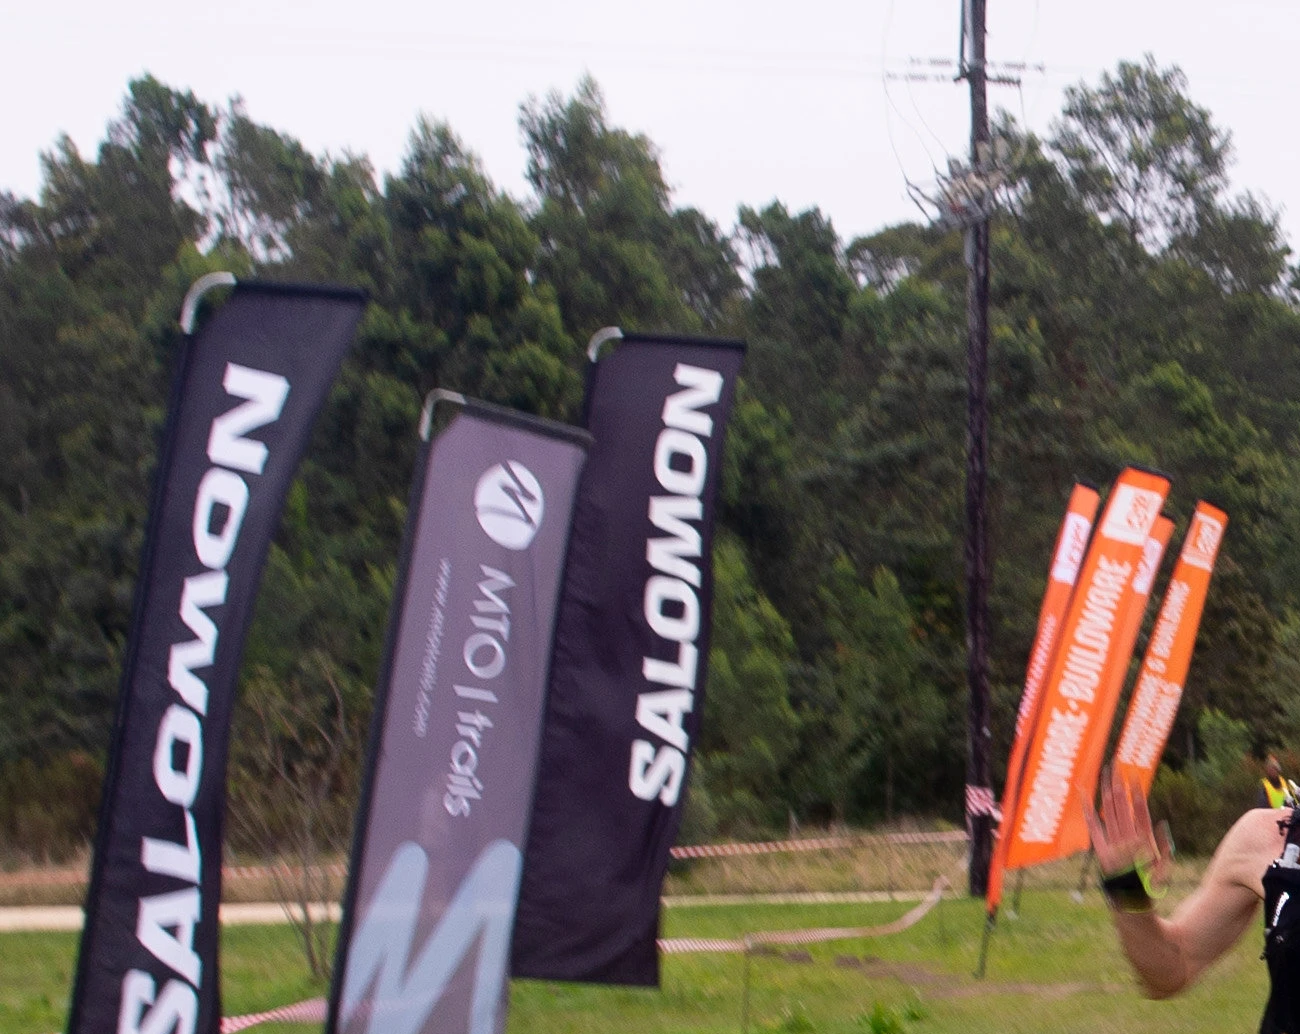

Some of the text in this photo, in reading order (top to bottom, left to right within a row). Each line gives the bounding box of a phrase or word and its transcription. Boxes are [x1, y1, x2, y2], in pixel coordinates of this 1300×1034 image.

[463, 564, 516, 679] MTO
[628, 363, 723, 807] SALOMON
[443, 709, 494, 818] trails
